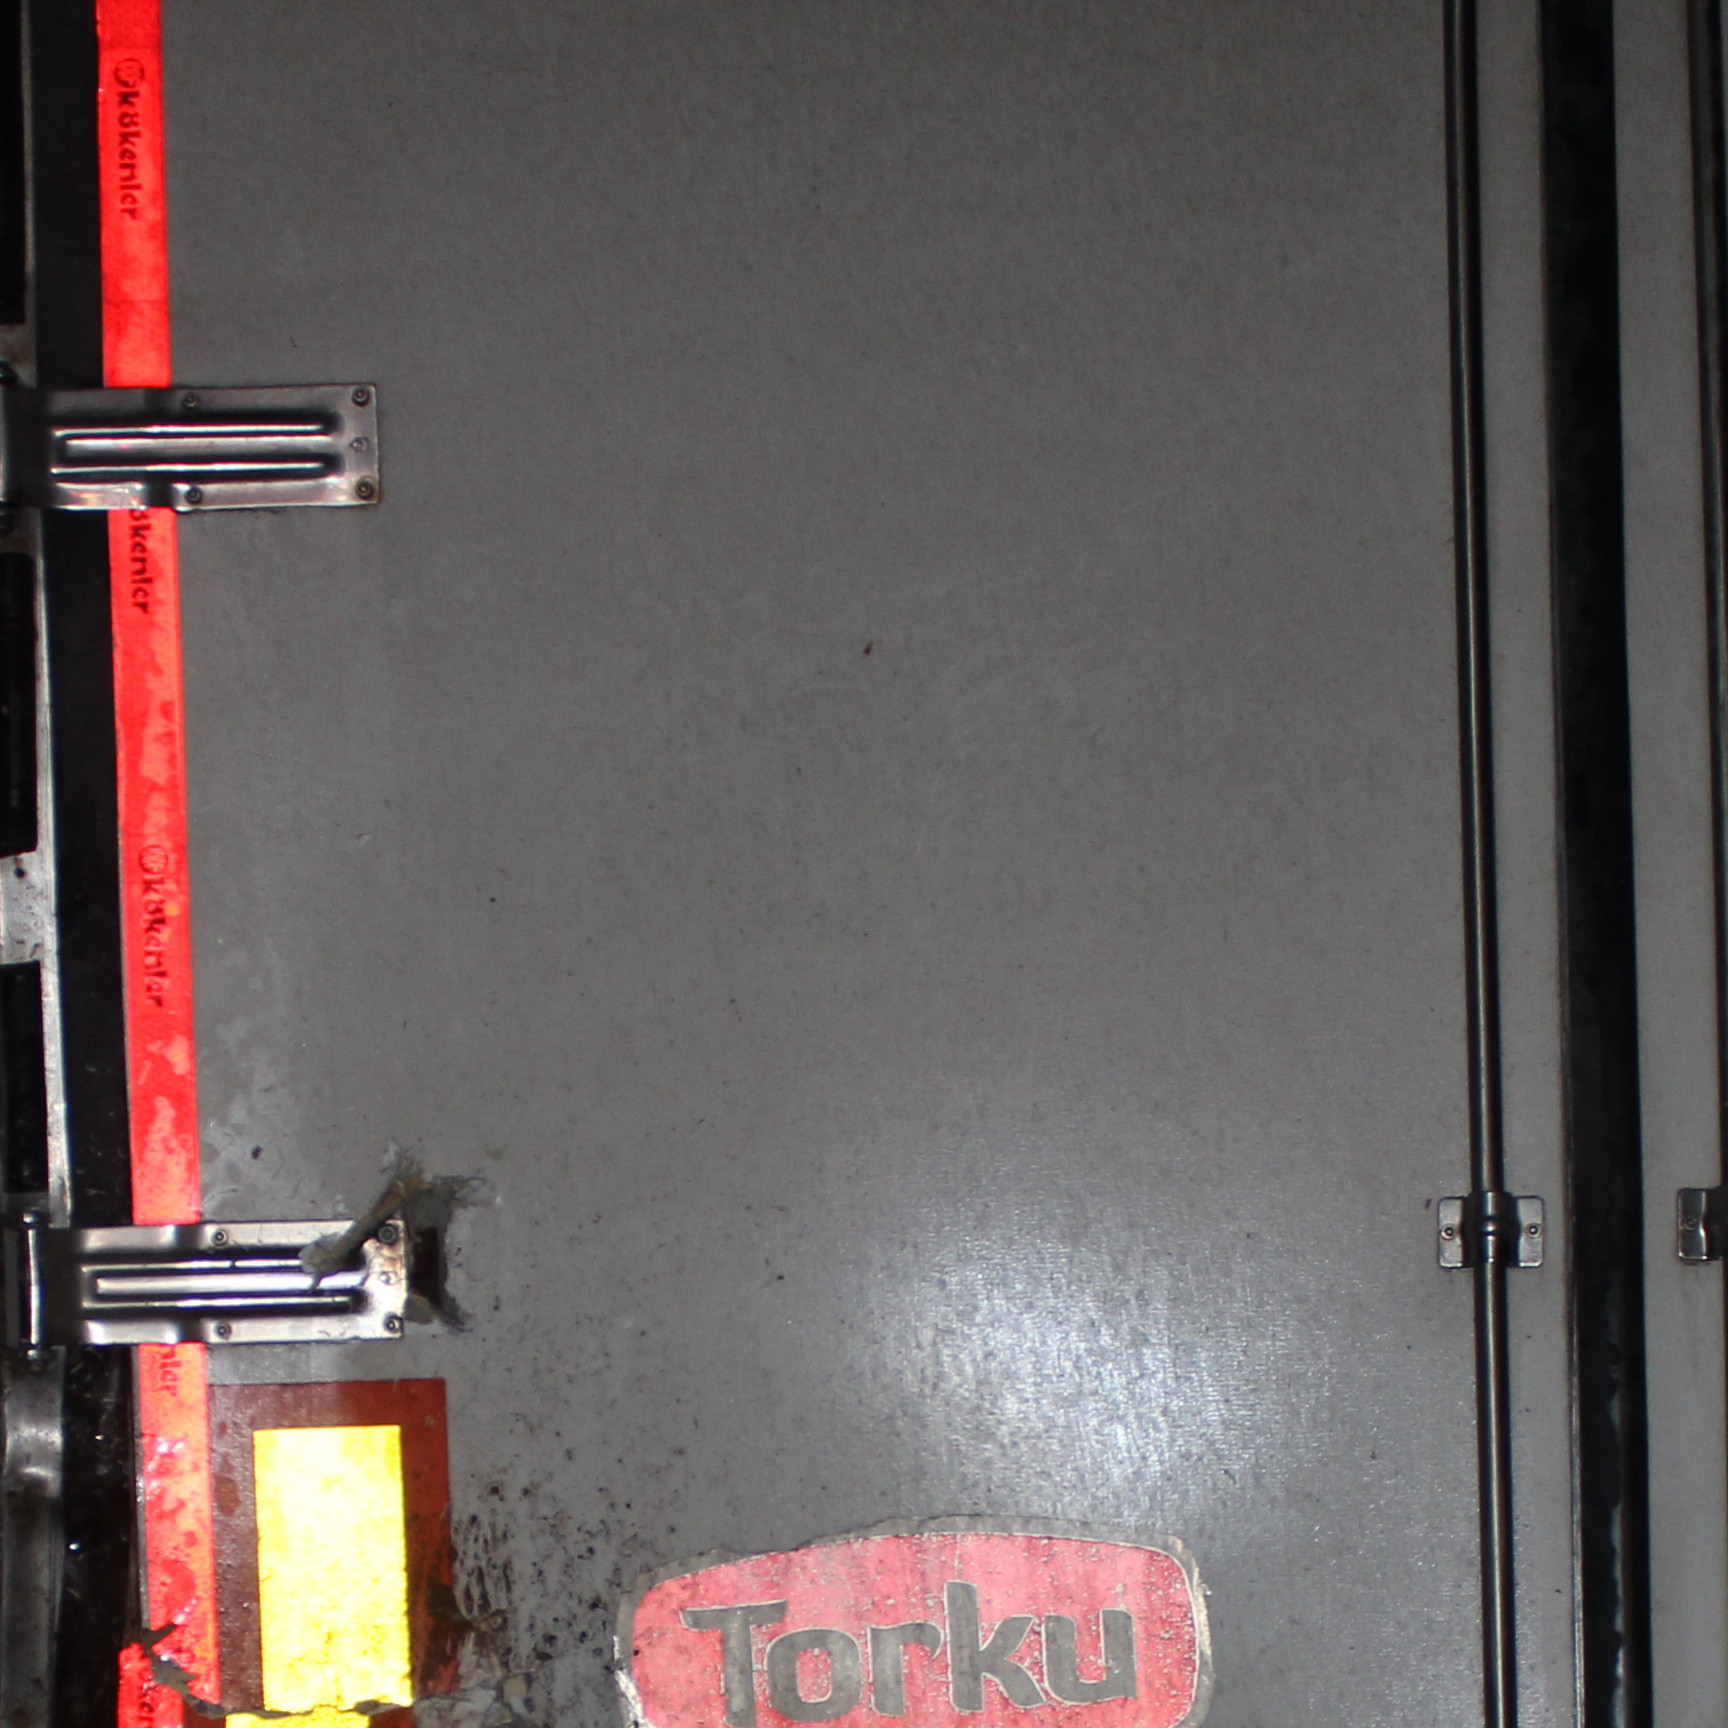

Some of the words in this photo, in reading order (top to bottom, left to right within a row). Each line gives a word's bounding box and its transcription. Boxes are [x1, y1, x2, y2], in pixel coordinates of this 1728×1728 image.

[118, 89, 142, 220] kökenler
[129, 508, 154, 614] ökenler
[142, 877, 169, 1008] kökenler
